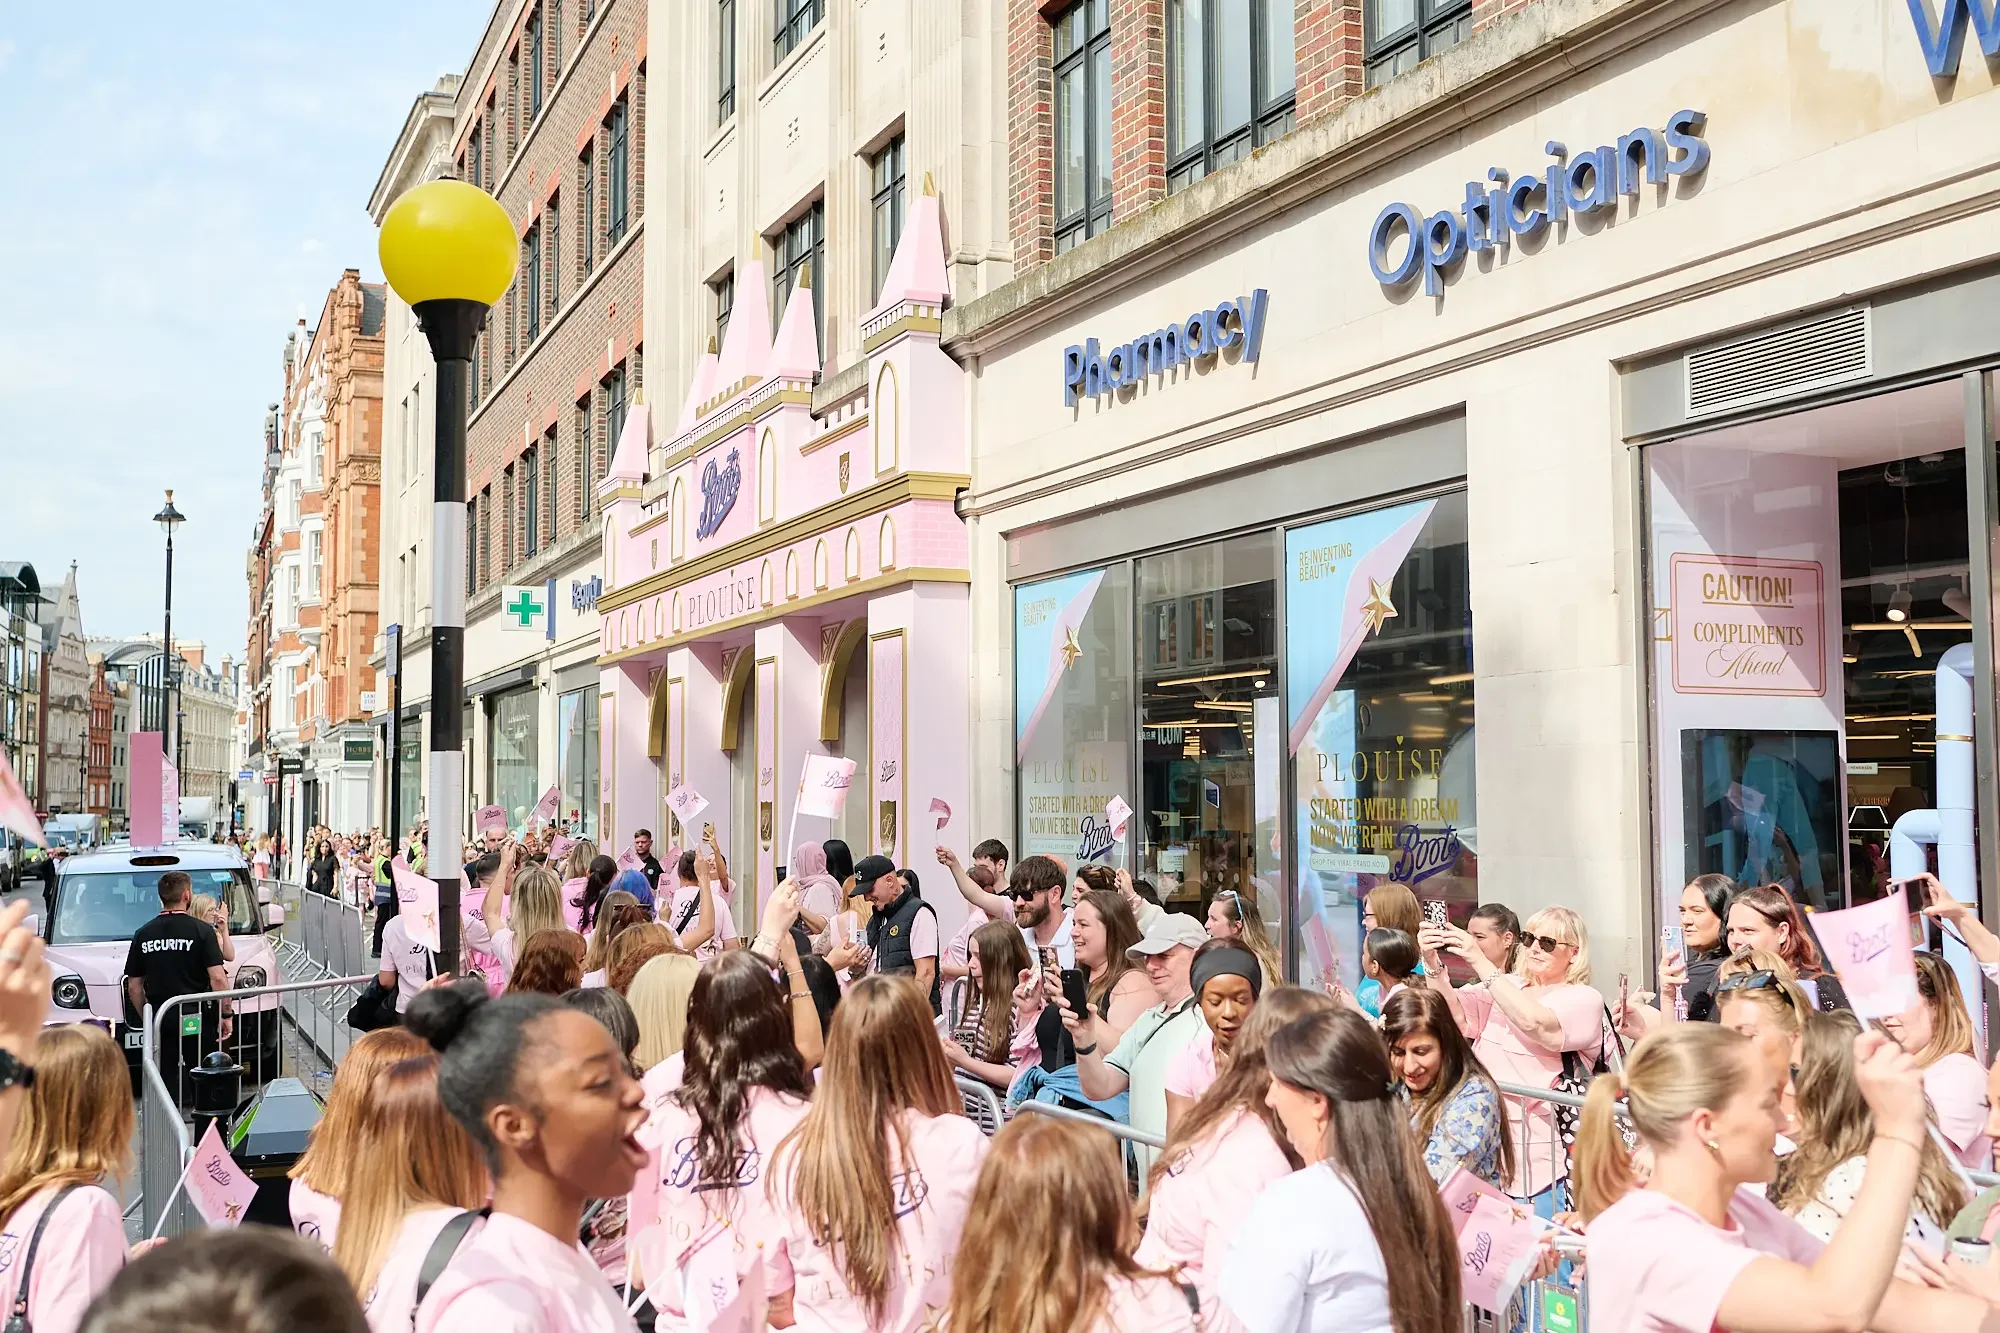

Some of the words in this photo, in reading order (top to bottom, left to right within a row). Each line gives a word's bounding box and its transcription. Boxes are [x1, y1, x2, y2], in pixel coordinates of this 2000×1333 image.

[1369, 109, 1711, 298] Opticians
[1065, 288, 1268, 407] Pharmacy
[696, 447, 742, 542] Boots
[1299, 542, 1352, 566] RE-INVENTING
[1299, 563, 1330, 582] BEAUTY
[1702, 573, 1793, 604] CAUTION!
[1693, 622, 1804, 646] COMPLIMENTS
[1705, 643, 1790, 680] Ahead
[1316, 740, 1443, 782] PLOUISE
[1029, 796, 1060, 814] STARTED
[1061, 795, 1081, 814] WITH
[1082, 795, 1088, 813] A
[1310, 798, 1361, 820] STARTED
[1363, 797, 1396, 820] WITH
[1399, 797, 1409, 820] A
[1411, 797, 1459, 820] DREAM
[1029, 816, 1046, 834] NOW
[1047, 816, 1070, 834] WE'RE
[1071, 816, 1080, 834] IN
[1310, 825, 1337, 848] NOW
[1340, 825, 1376, 848] WE'RE
[1379, 825, 1393, 848] IN
[1389, 824, 1461, 886] Boots
[141, 938, 194, 954] SECURITY
